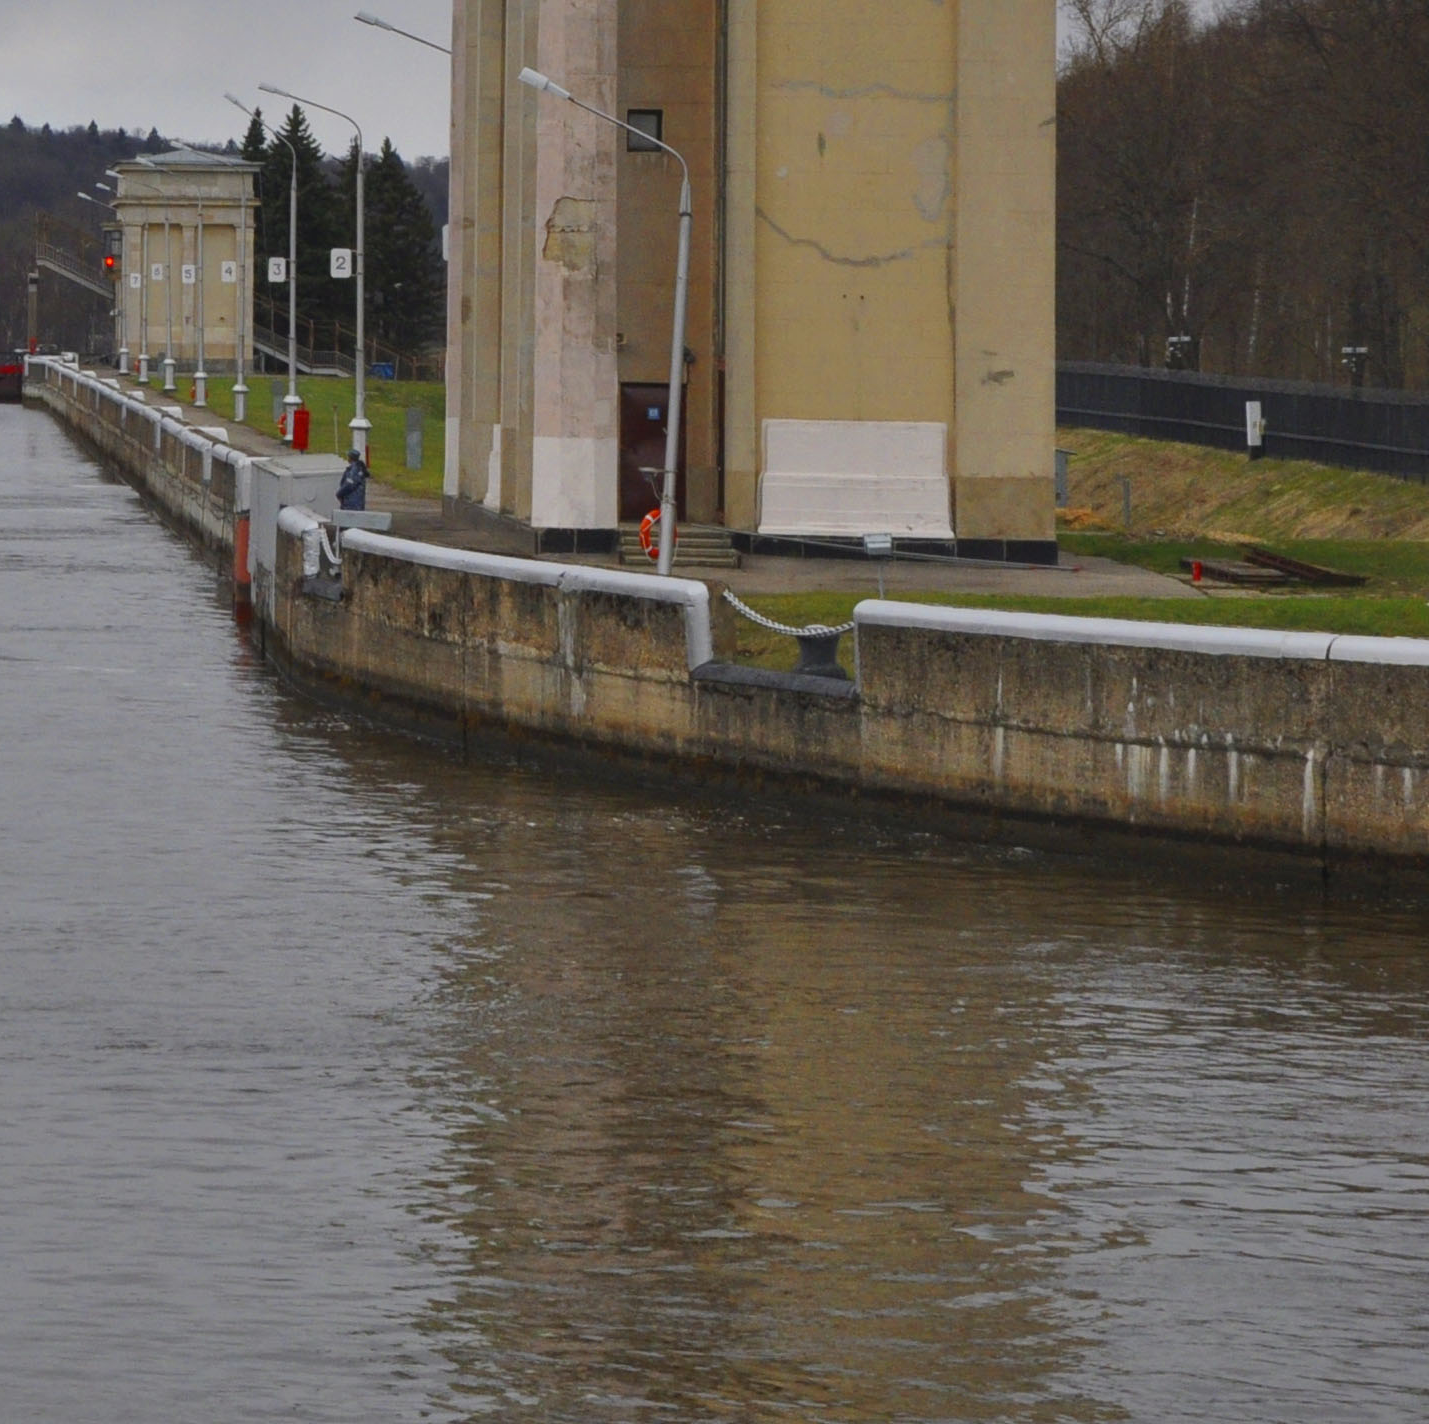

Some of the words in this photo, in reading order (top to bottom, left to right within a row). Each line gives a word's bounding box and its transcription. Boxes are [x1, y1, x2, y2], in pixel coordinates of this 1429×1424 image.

[272, 263, 282, 276] 3
[335, 256, 347, 271] 2
[184, 269, 192, 279] 5
[224, 266, 233, 277] 4
